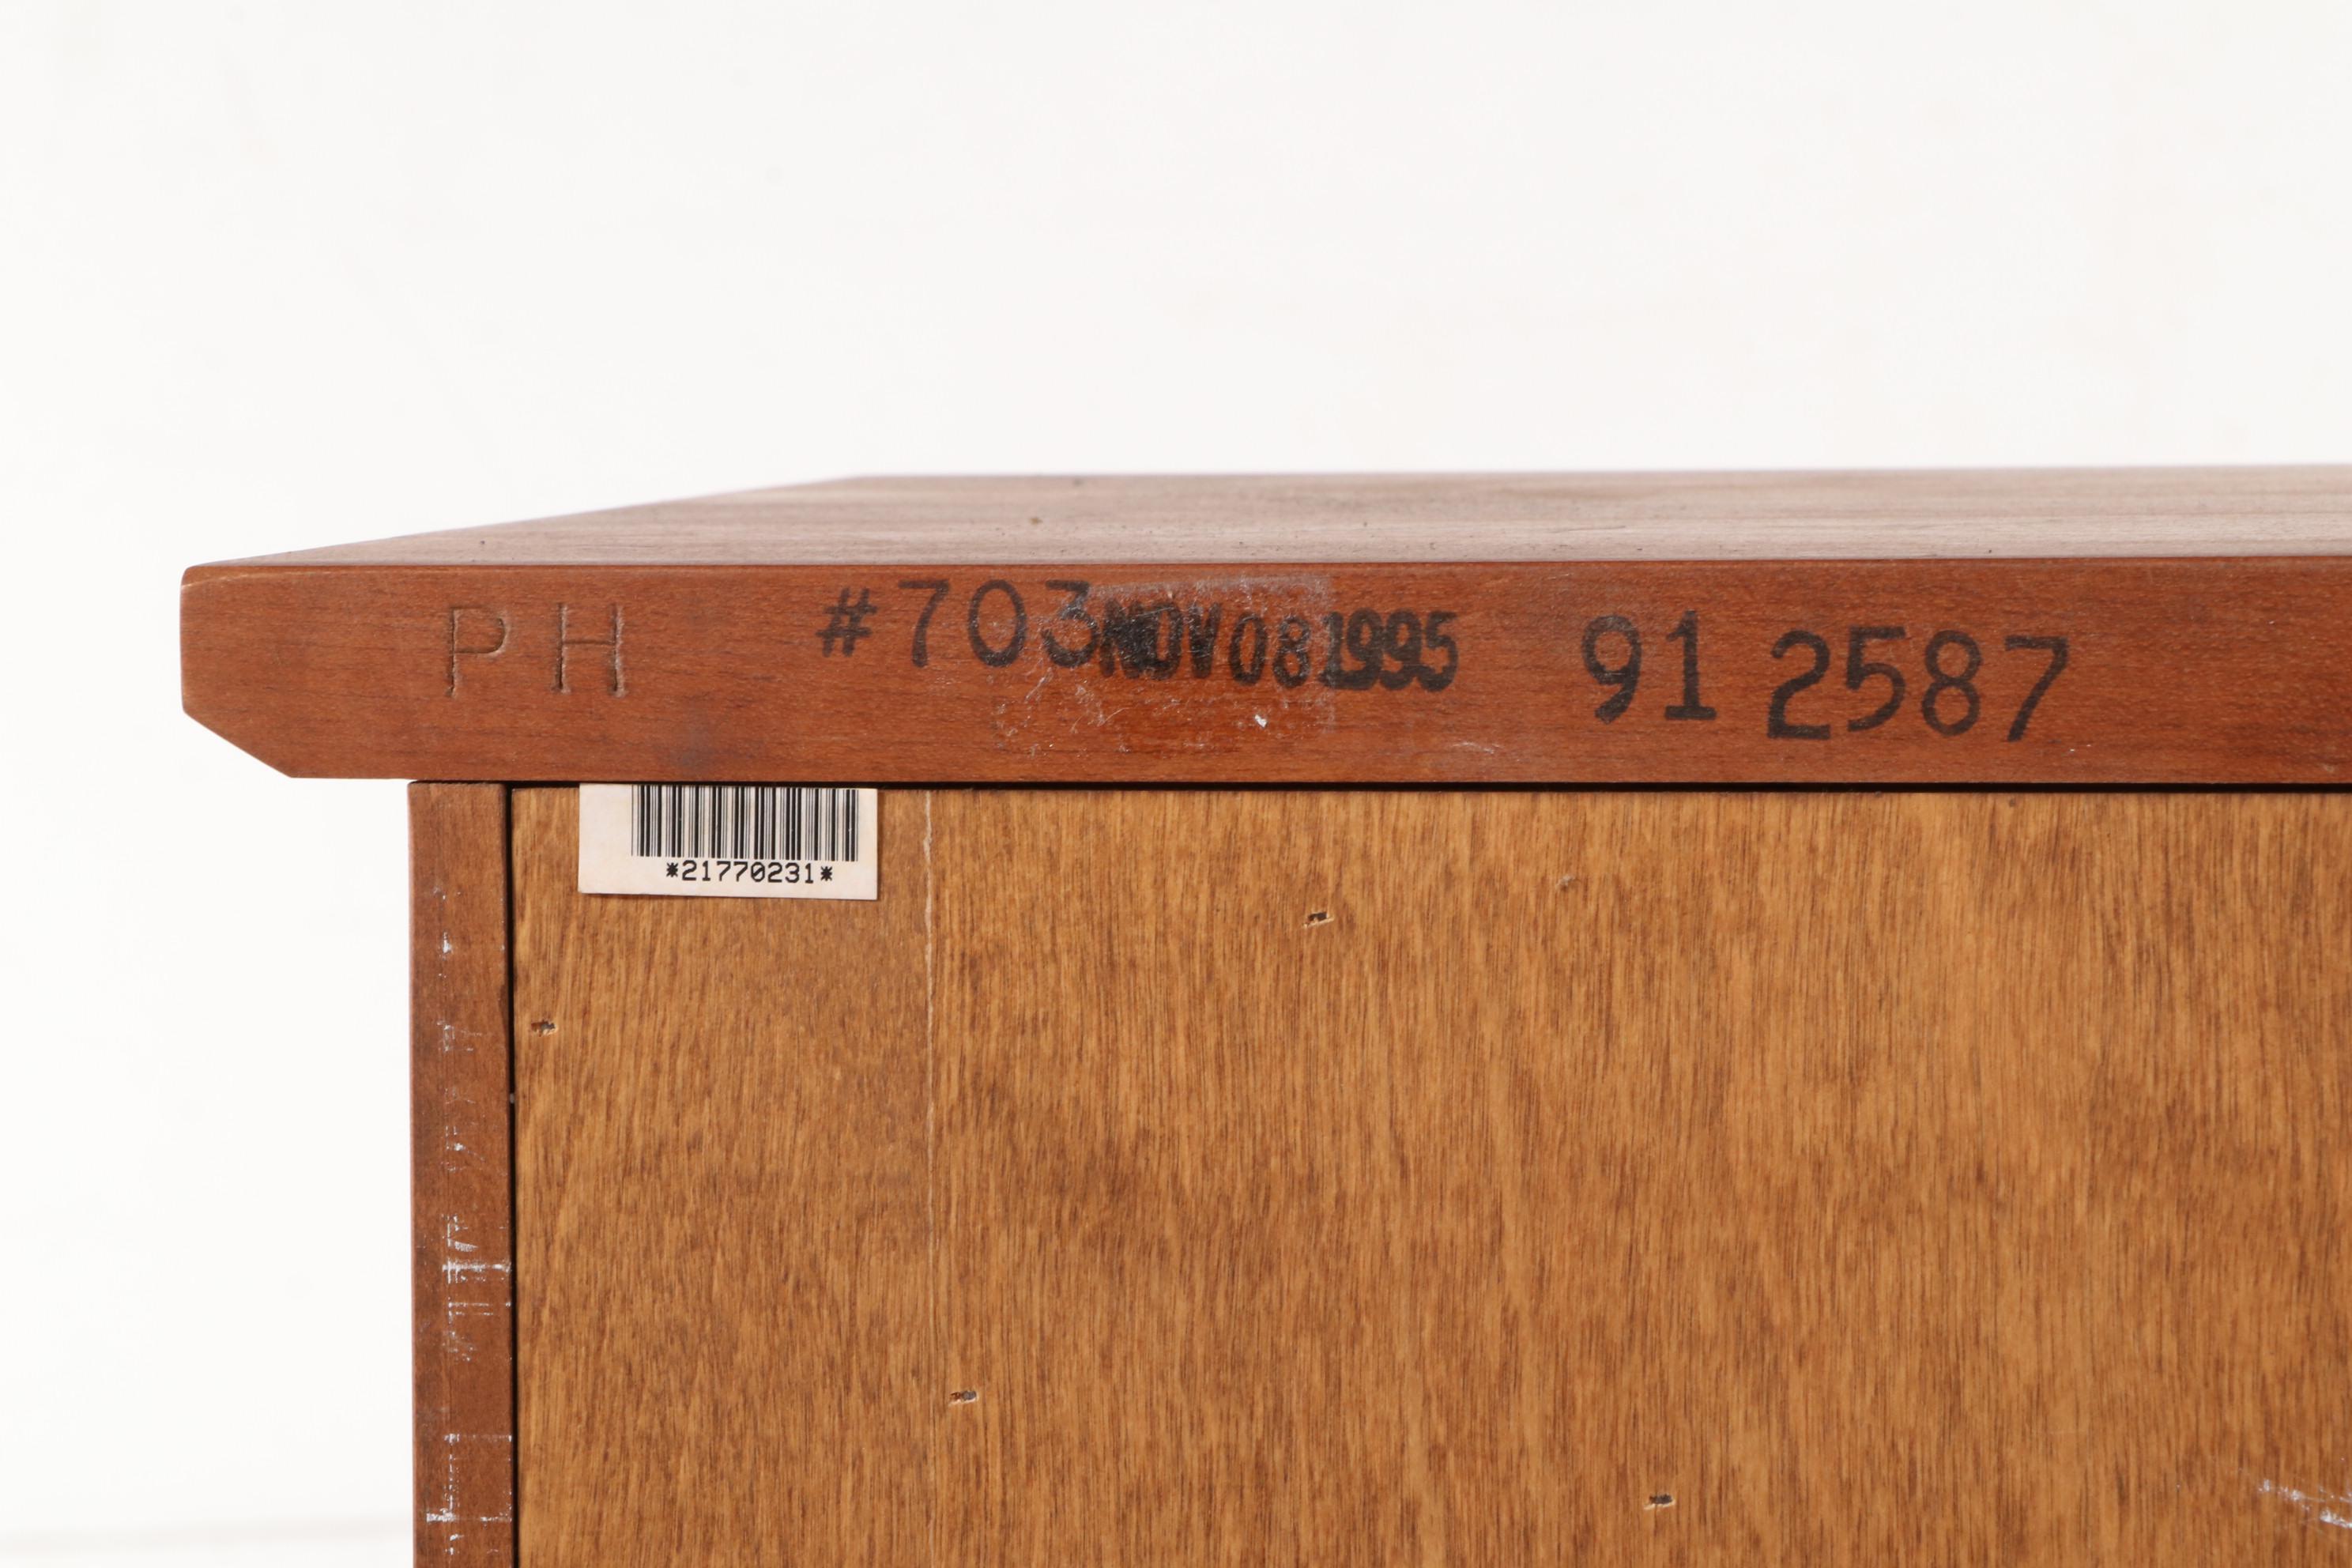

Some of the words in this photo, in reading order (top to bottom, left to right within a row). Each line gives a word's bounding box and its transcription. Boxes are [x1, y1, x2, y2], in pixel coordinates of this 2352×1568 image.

[1228, 610, 1310, 689] 08
[1317, 606, 1459, 692] 1995
[1766, 625, 2069, 742] 2587
